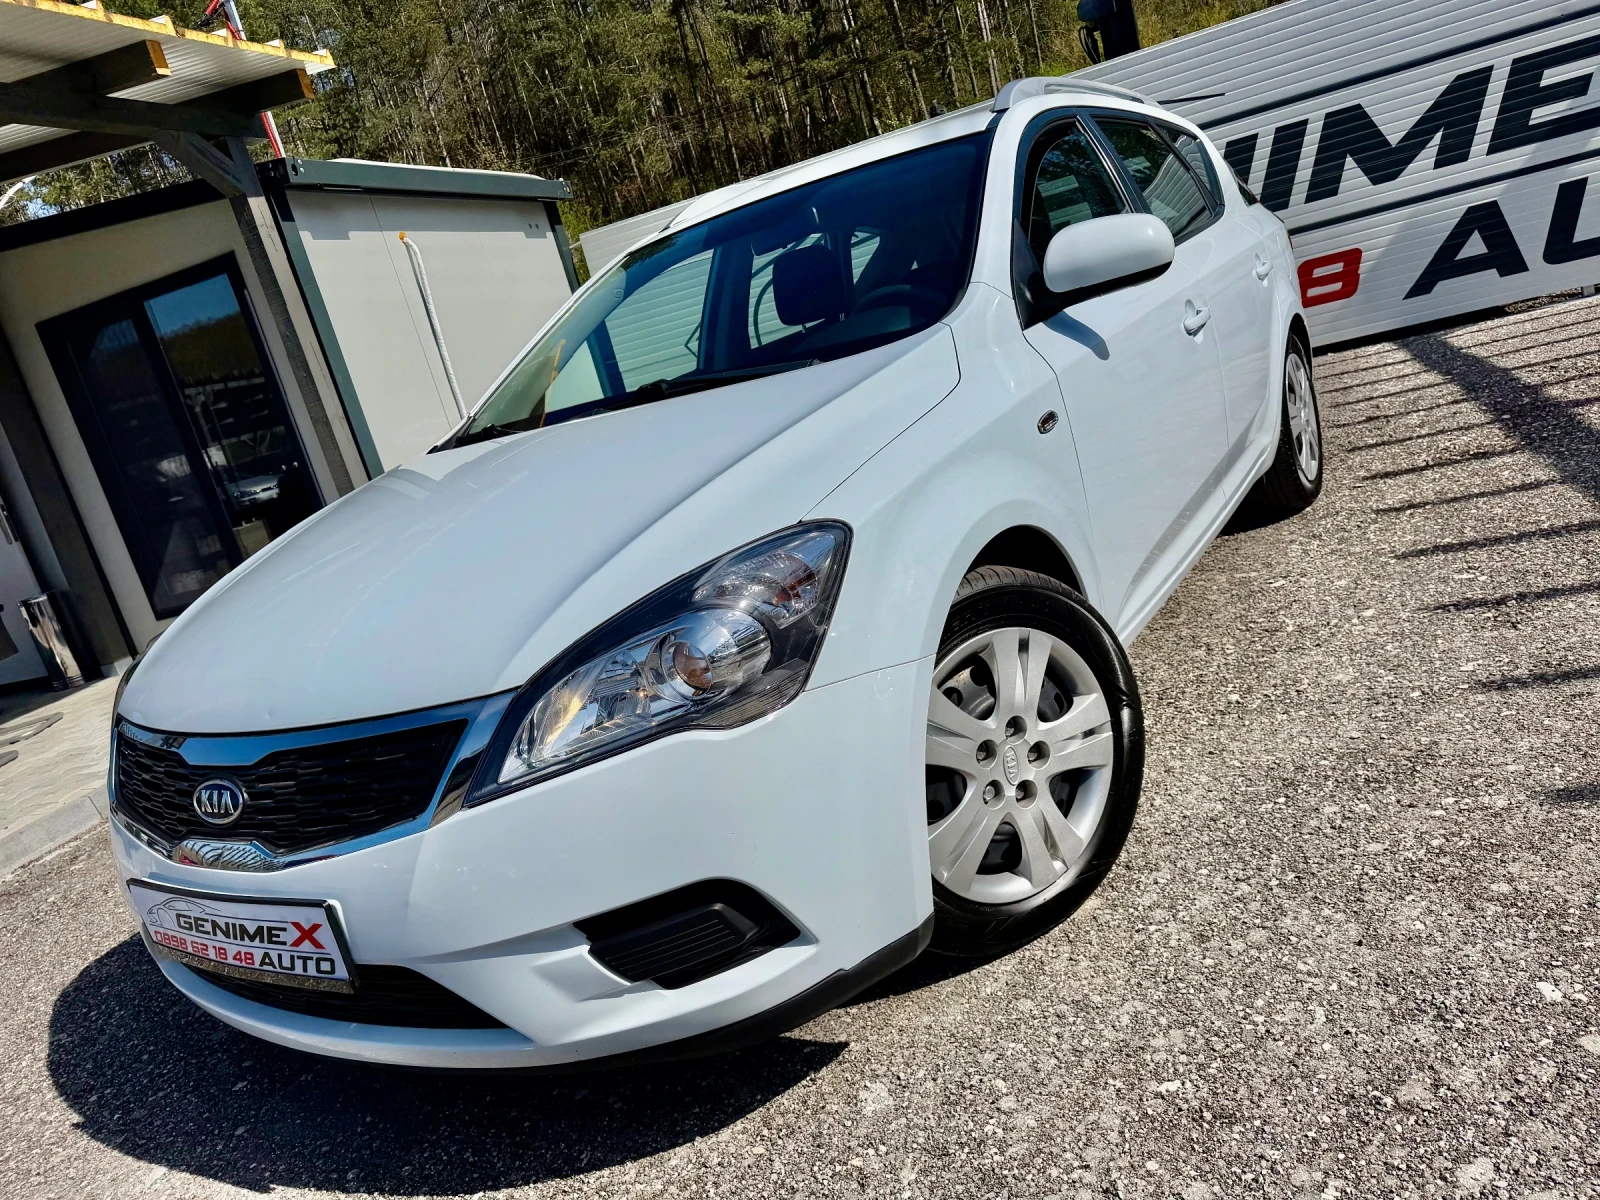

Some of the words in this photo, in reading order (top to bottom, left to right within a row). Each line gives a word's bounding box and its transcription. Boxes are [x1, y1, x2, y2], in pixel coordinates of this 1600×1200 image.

[200, 789, 235, 814] KIA
[176, 912, 326, 950] GENIMEX
[154, 930, 188, 951] 0898
[212, 945, 228, 961] 18
[232, 950, 255, 966] 48
[259, 951, 336, 976] AUTO
